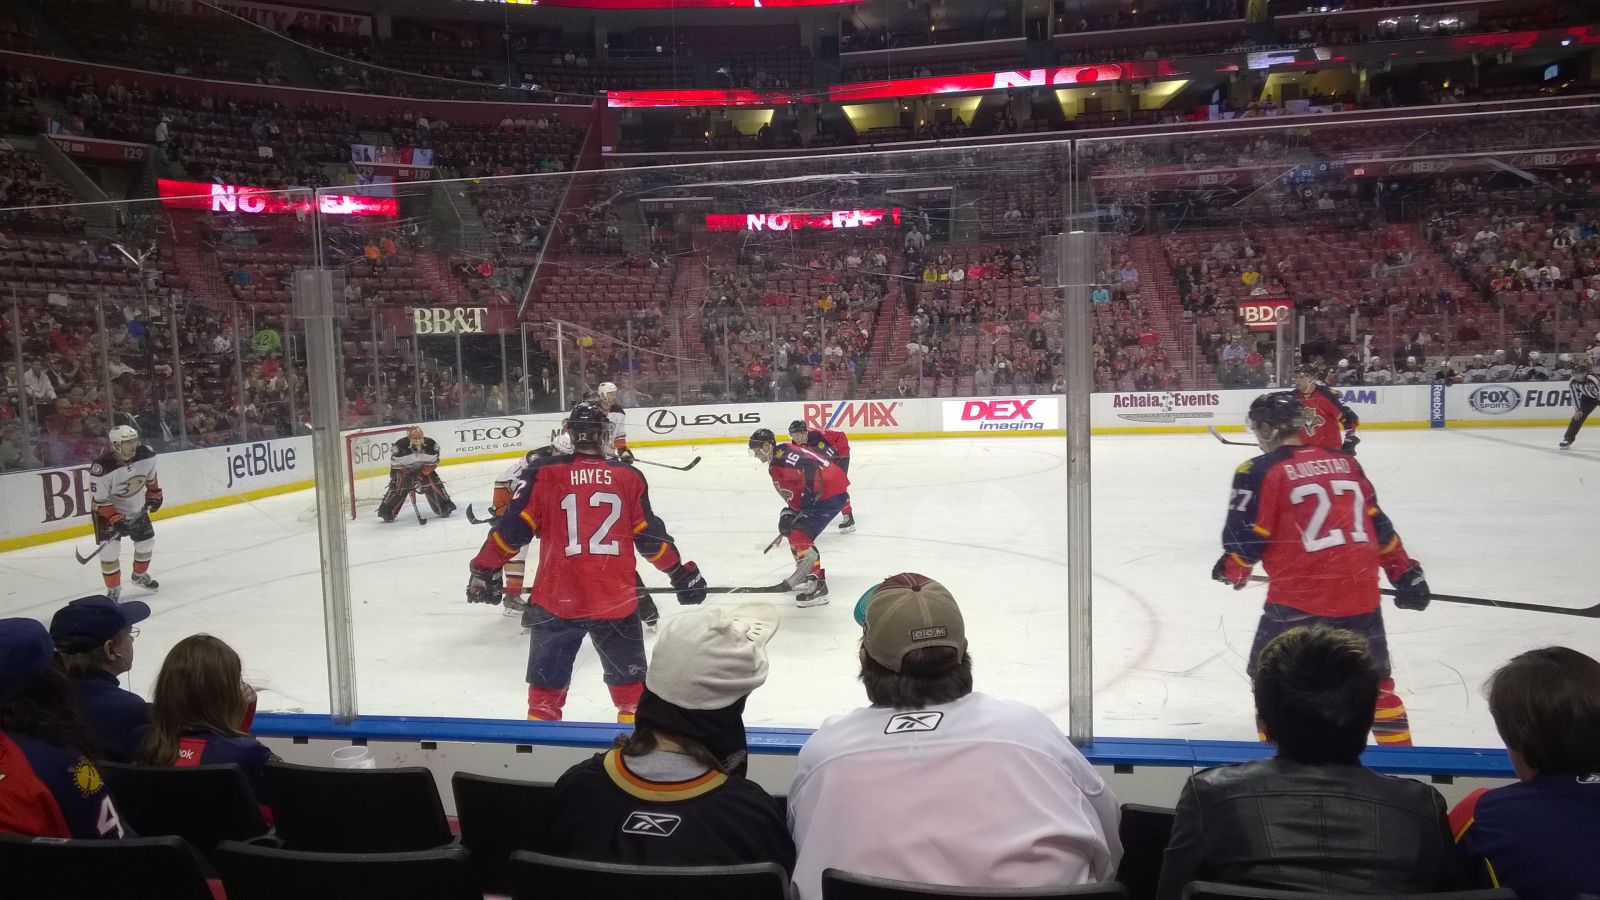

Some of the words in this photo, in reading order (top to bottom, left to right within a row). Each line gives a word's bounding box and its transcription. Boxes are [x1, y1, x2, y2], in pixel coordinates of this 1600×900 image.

[124, 147, 143, 159] 129
[413, 307, 487, 334] BB&T
[1113, 393, 1160, 408] Achaia
[1174, 392, 1220, 407] Events
[1432, 384, 1444, 422] Reebok
[1480, 391, 1509, 403] FOX
[961, 399, 1037, 421] DEX
[681, 412, 761, 426] LEXUS
[979, 420, 1044, 431] imaging
[455, 425, 522, 443] TECO
[455, 443, 499, 453] PEOPLES
[502, 441, 523, 449] GAS
[226, 442, 296, 489] jetBlue
[785, 452, 801, 467] 16
[570, 469, 613, 486] HAYES
[1283, 458, 1351, 481] BJUGSTAD
[560, 491, 622, 557] 12
[1289, 480, 1370, 553] 27
[912, 628, 946, 640] CCM
